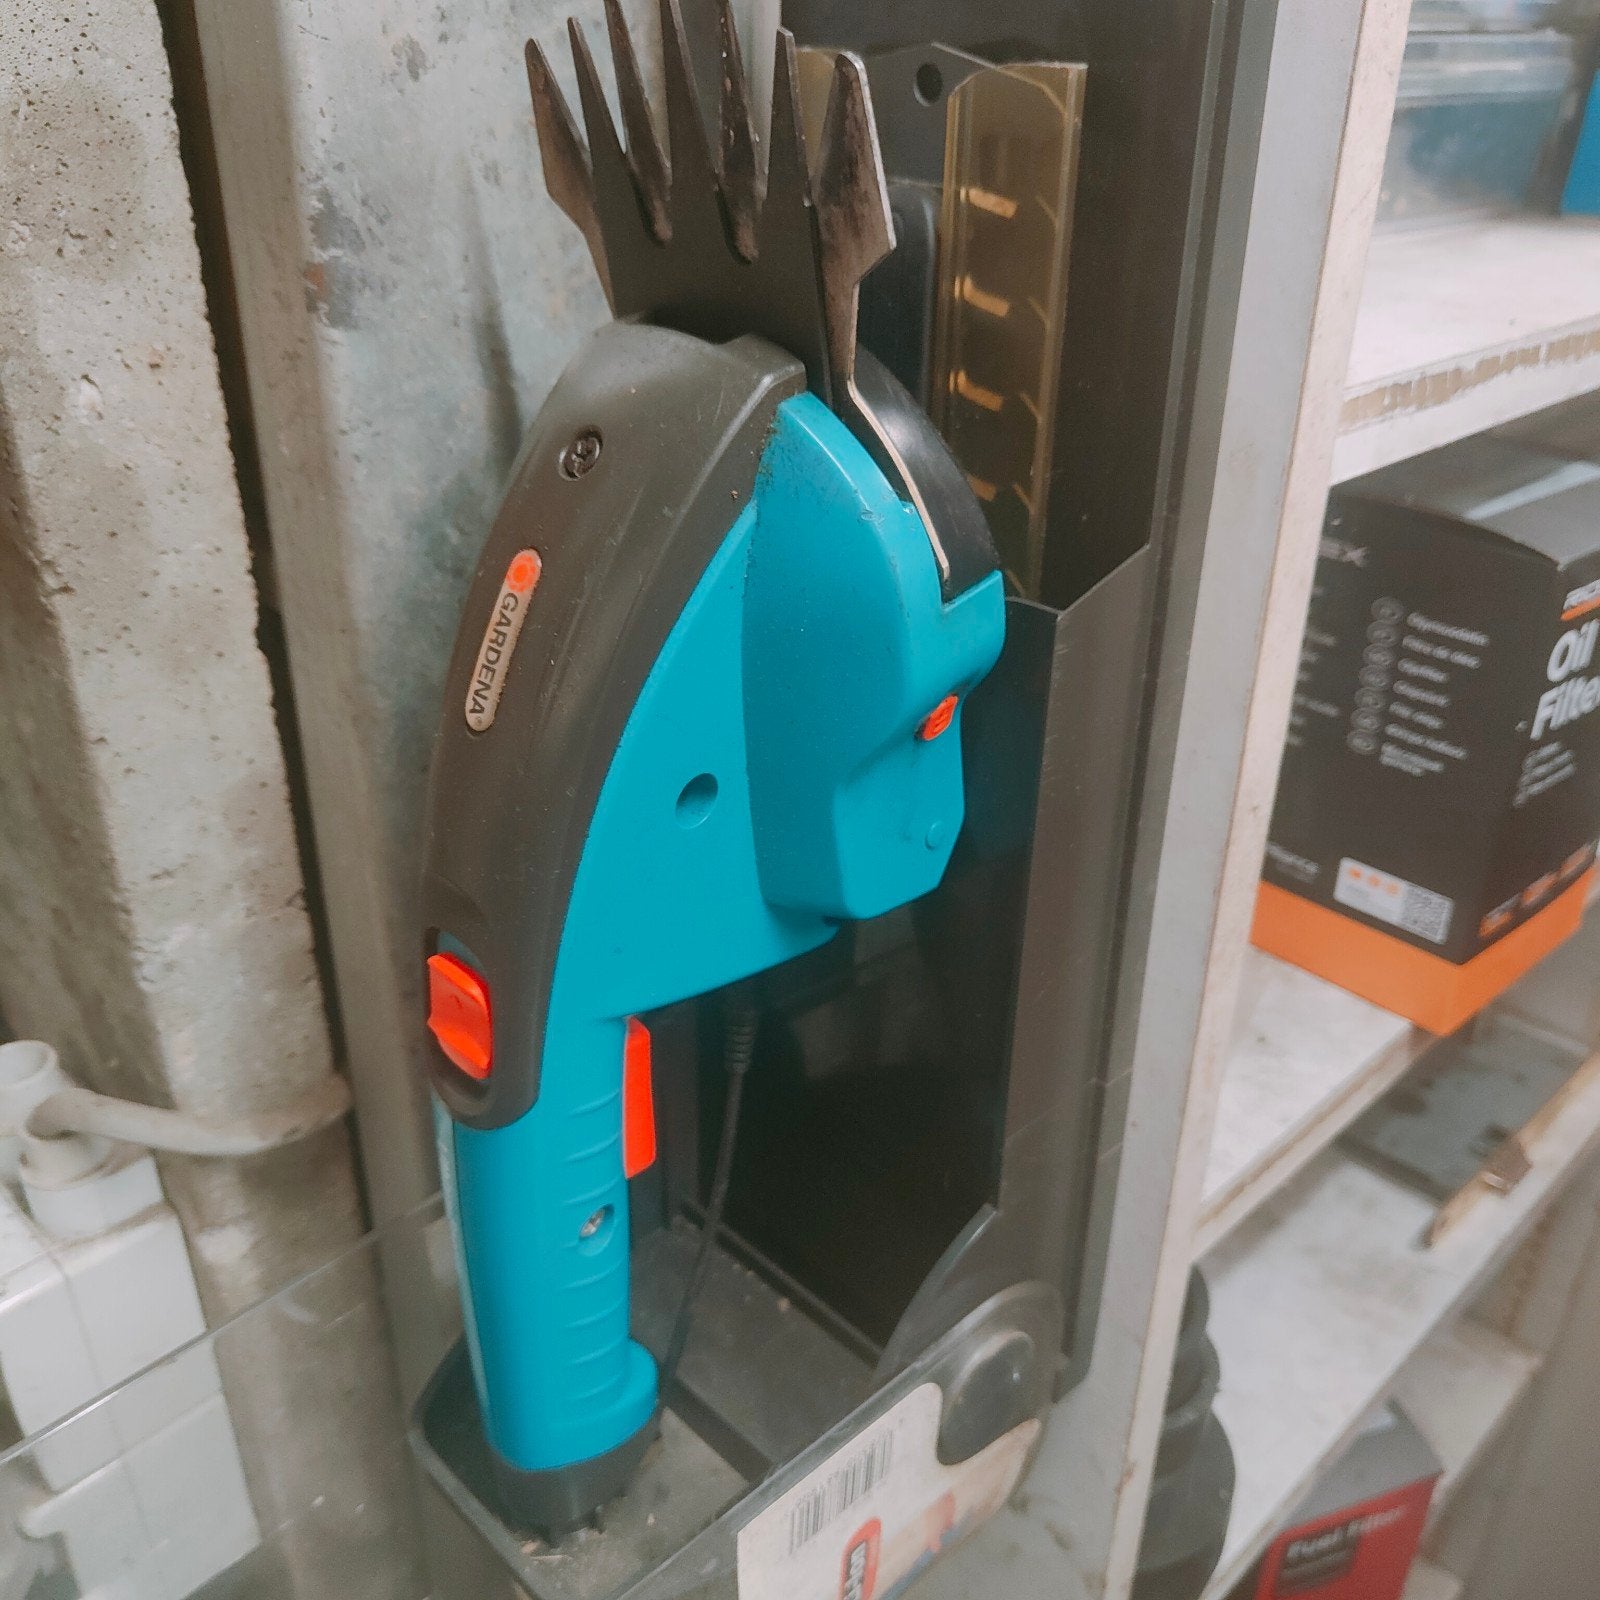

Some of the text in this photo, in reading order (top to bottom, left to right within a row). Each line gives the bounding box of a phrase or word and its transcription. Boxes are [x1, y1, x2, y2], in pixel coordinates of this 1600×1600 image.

[468, 592, 519, 715] GARDENA
[1547, 619, 1600, 682] Oil
[1529, 675, 1600, 741] Filte
